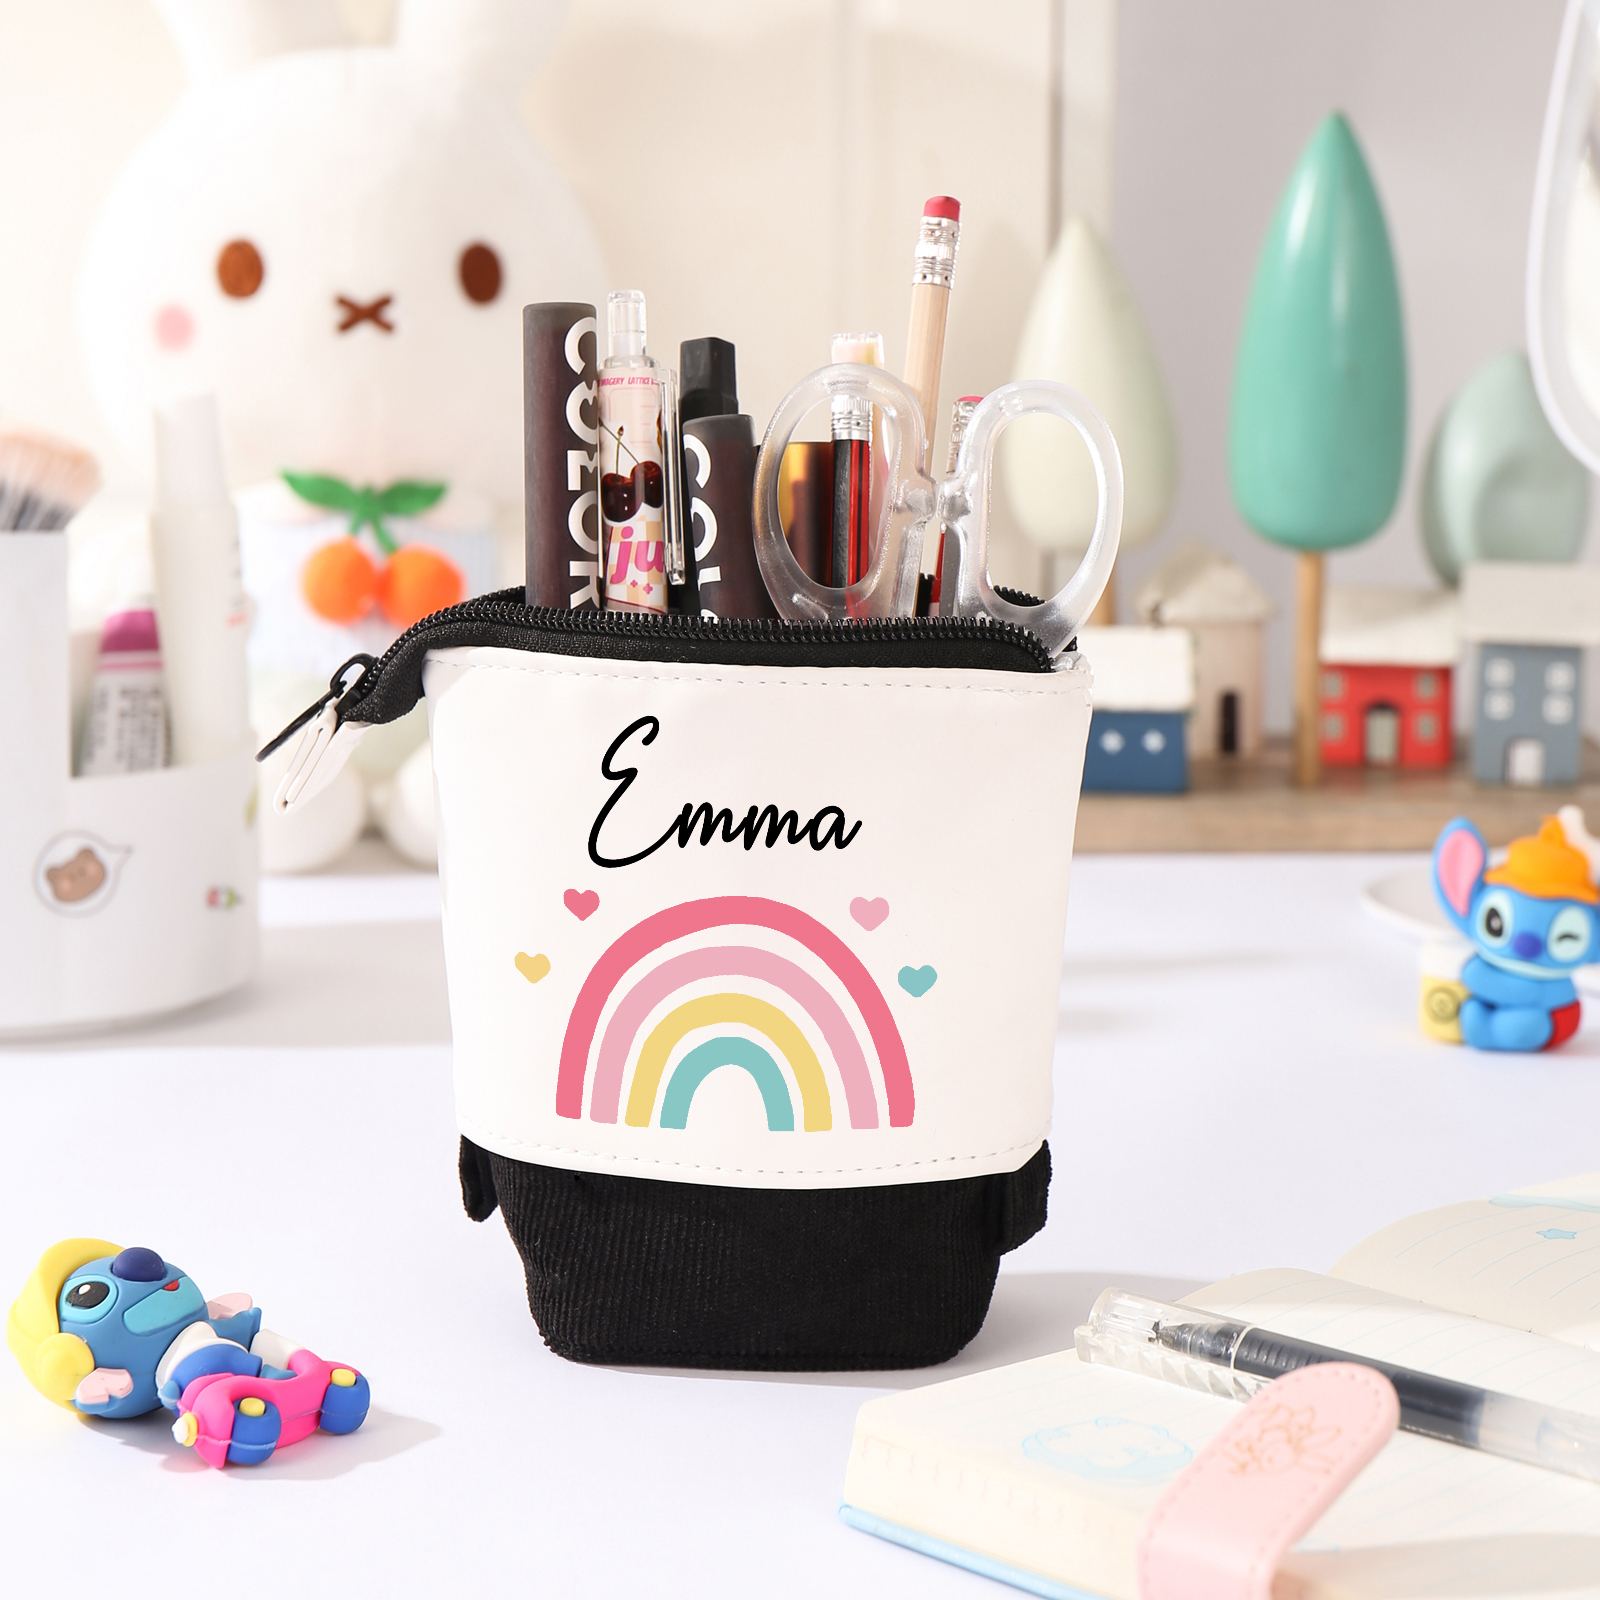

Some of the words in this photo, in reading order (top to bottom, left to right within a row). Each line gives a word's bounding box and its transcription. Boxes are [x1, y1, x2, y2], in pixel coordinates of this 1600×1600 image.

[628, 376, 650, 385] LATTICE
[564, 316, 600, 609] COLOR
[610, 526, 663, 584] ju
[588, 716, 862, 868] Emma
